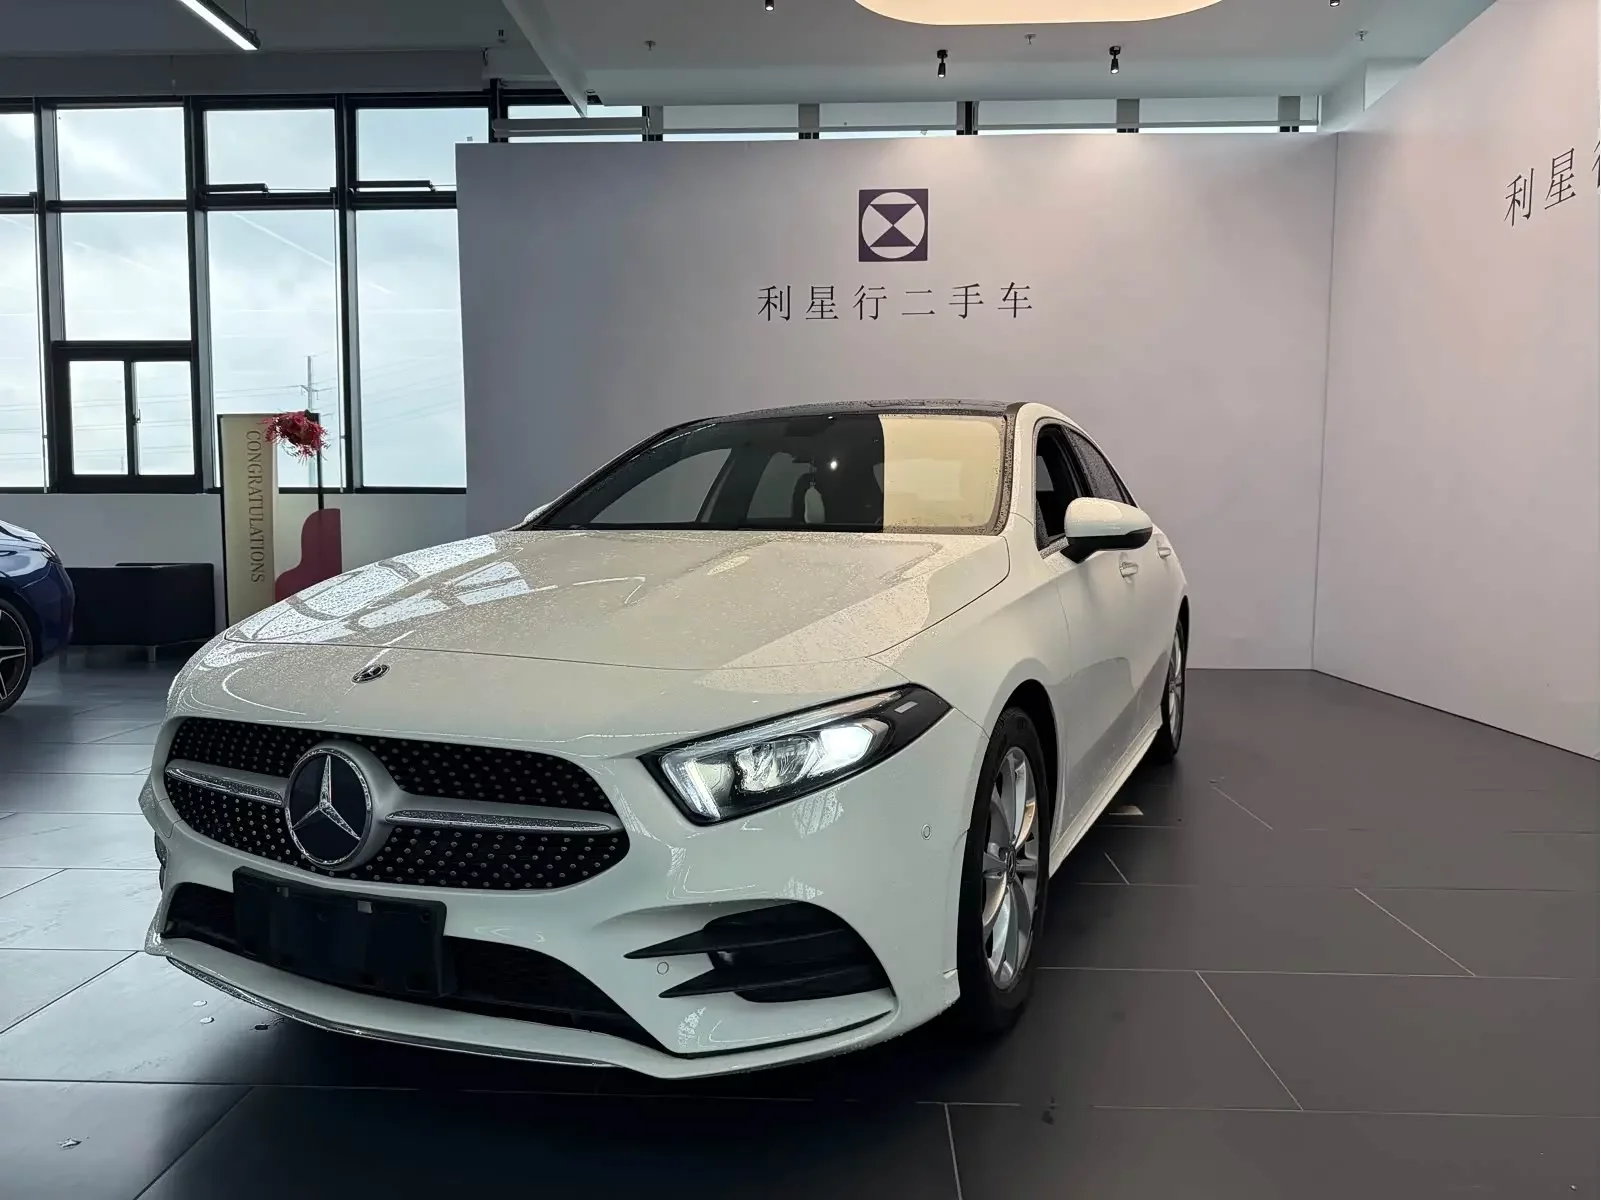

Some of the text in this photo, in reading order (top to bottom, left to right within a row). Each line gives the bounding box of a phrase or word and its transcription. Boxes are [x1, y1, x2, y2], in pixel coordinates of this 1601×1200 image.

[757, 281, 1032, 322] 利星行二手车
[246, 430, 265, 583] CONGRATULATIONS
